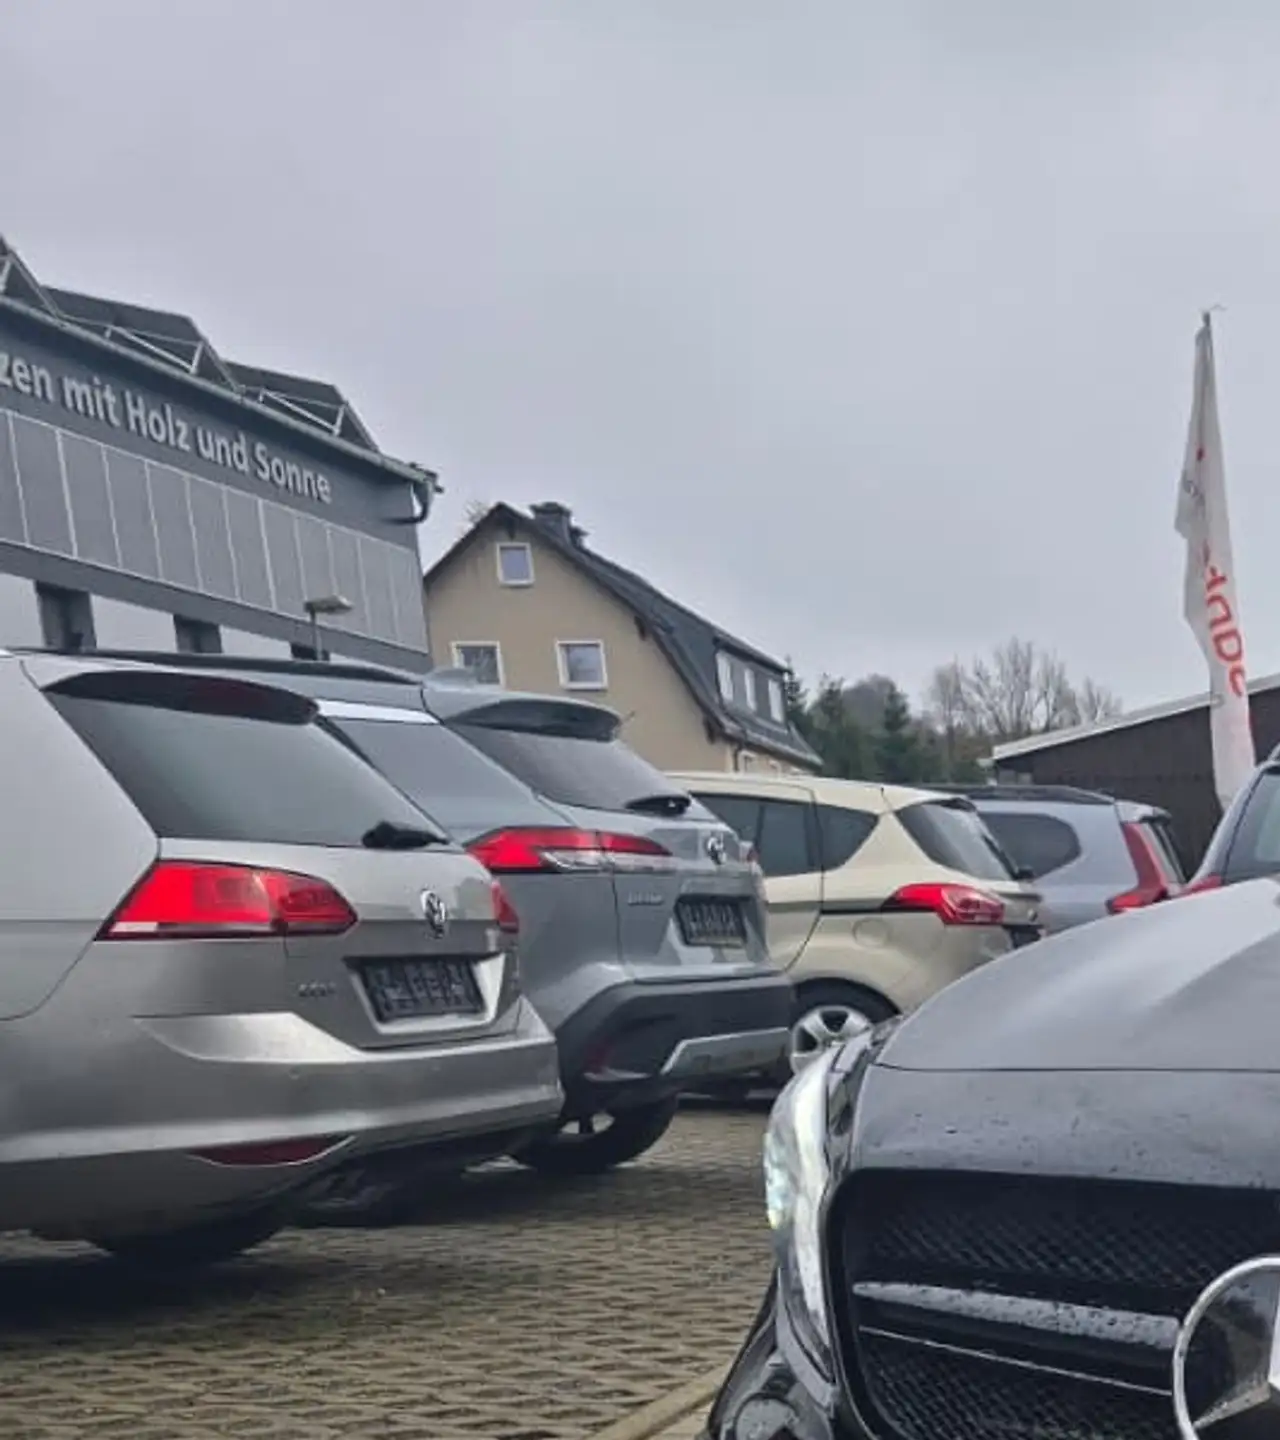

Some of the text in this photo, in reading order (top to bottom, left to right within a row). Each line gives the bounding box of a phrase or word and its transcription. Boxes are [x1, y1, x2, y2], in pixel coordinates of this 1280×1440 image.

[63, 374, 120, 427] mit
[126, 390, 192, 451] Holz
[197, 425, 250, 474] und
[256, 440, 333, 503] Sonne
